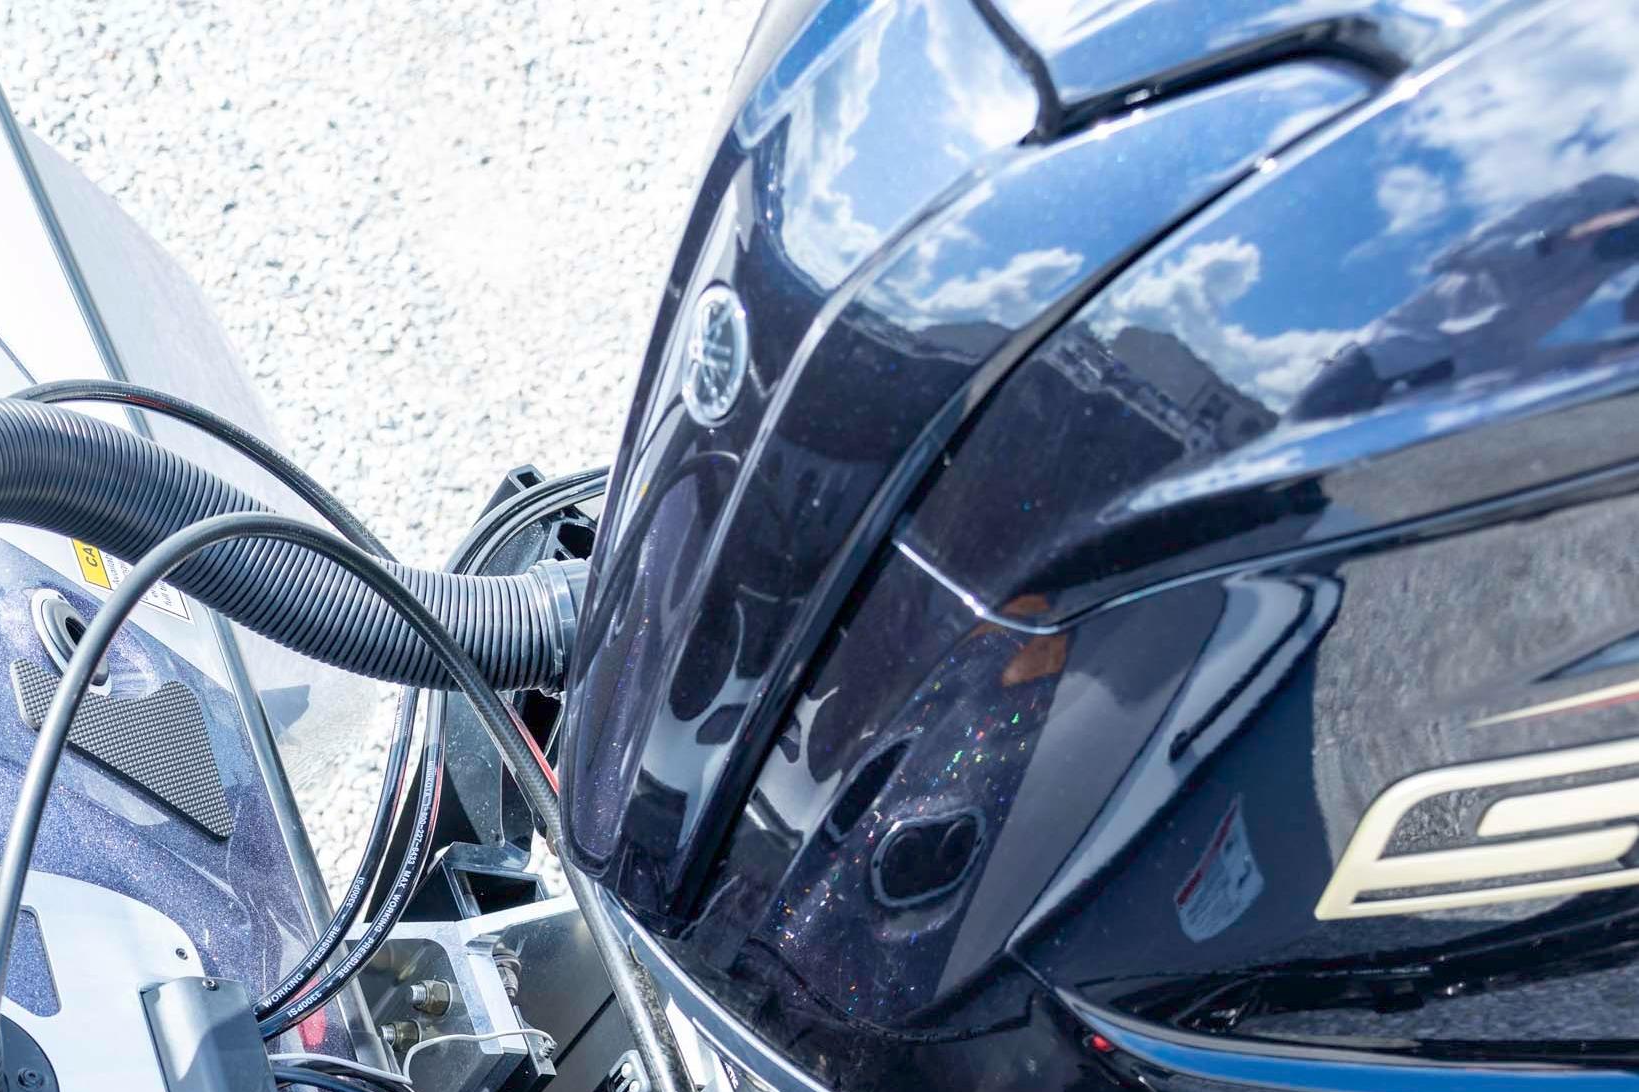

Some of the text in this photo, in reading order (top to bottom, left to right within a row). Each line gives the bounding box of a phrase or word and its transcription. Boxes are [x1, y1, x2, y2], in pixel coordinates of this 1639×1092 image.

[397, 870, 412, 888] MAX
[374, 894, 401, 933] WORKING
[261, 974, 304, 1008] WORKING
[305, 926, 341, 970] PRESSURE
[345, 876, 365, 909] 3300PSI
[337, 937, 374, 979] PRESSURE
[287, 990, 322, 1018] 3300PSI
